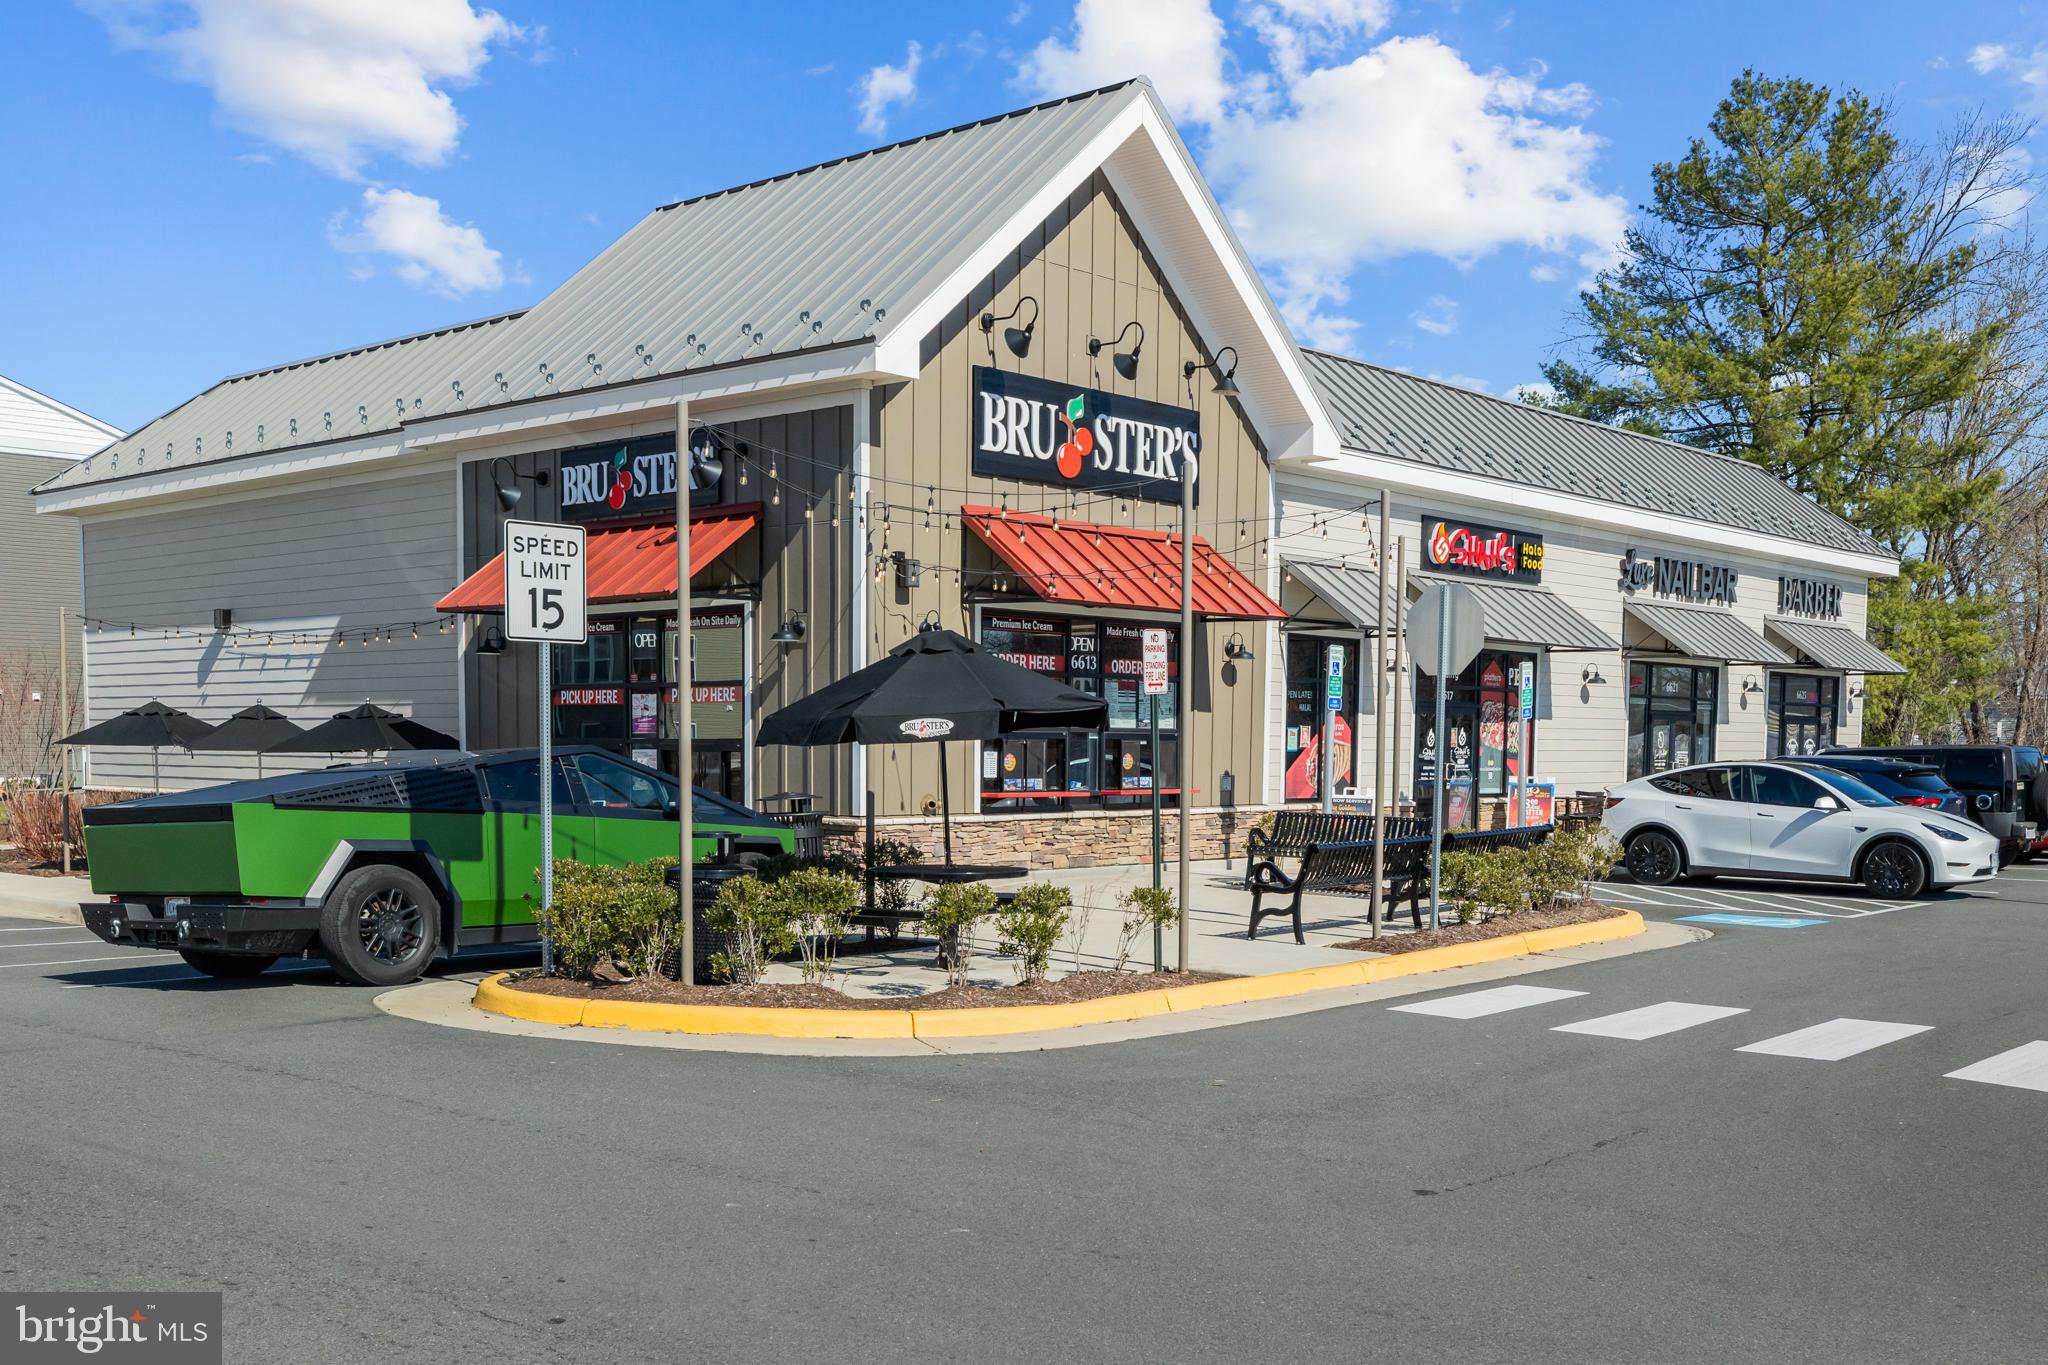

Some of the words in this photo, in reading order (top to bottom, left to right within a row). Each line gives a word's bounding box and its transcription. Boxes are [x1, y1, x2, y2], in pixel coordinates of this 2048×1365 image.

[513, 536, 578, 557] SPEED
[1522, 543, 1544, 557] Halal
[521, 561, 571, 580] LIMIT
[1522, 557, 1543, 570] Food
[1623, 549, 1654, 590] Luxe
[1659, 559, 1701, 598] NAIL
[1701, 564, 1738, 602] BAR
[1783, 578, 1842, 617] BARBER
[528, 587, 564, 629] 15
[596, 622, 615, 632] Cream
[701, 617, 711, 626] On
[711, 615, 724, 626] Site
[725, 615, 741, 627] Daily
[992, 618, 1021, 629] Premium
[1022, 620, 1031, 630] Ice
[1032, 620, 1053, 631] Cream
[1106, 626, 1122, 636] Made
[1123, 627, 1138, 637] Fresh
[1151, 634, 1159, 643] NO
[1029, 655, 1056, 670] HERE
[1071, 655, 1097, 669] 6613
[1112, 660, 1143, 674] ORDER
[1146, 672, 1154, 681] FIRE
[1155, 672, 1165, 681] LANE
[1666, 682, 1678, 692] 6621
[561, 689, 580, 704] PICK
[582, 690, 594, 704] UP
[595, 690, 618, 703] HERE
[696, 688, 709, 702] UP
[711, 687, 736, 702] HERE
